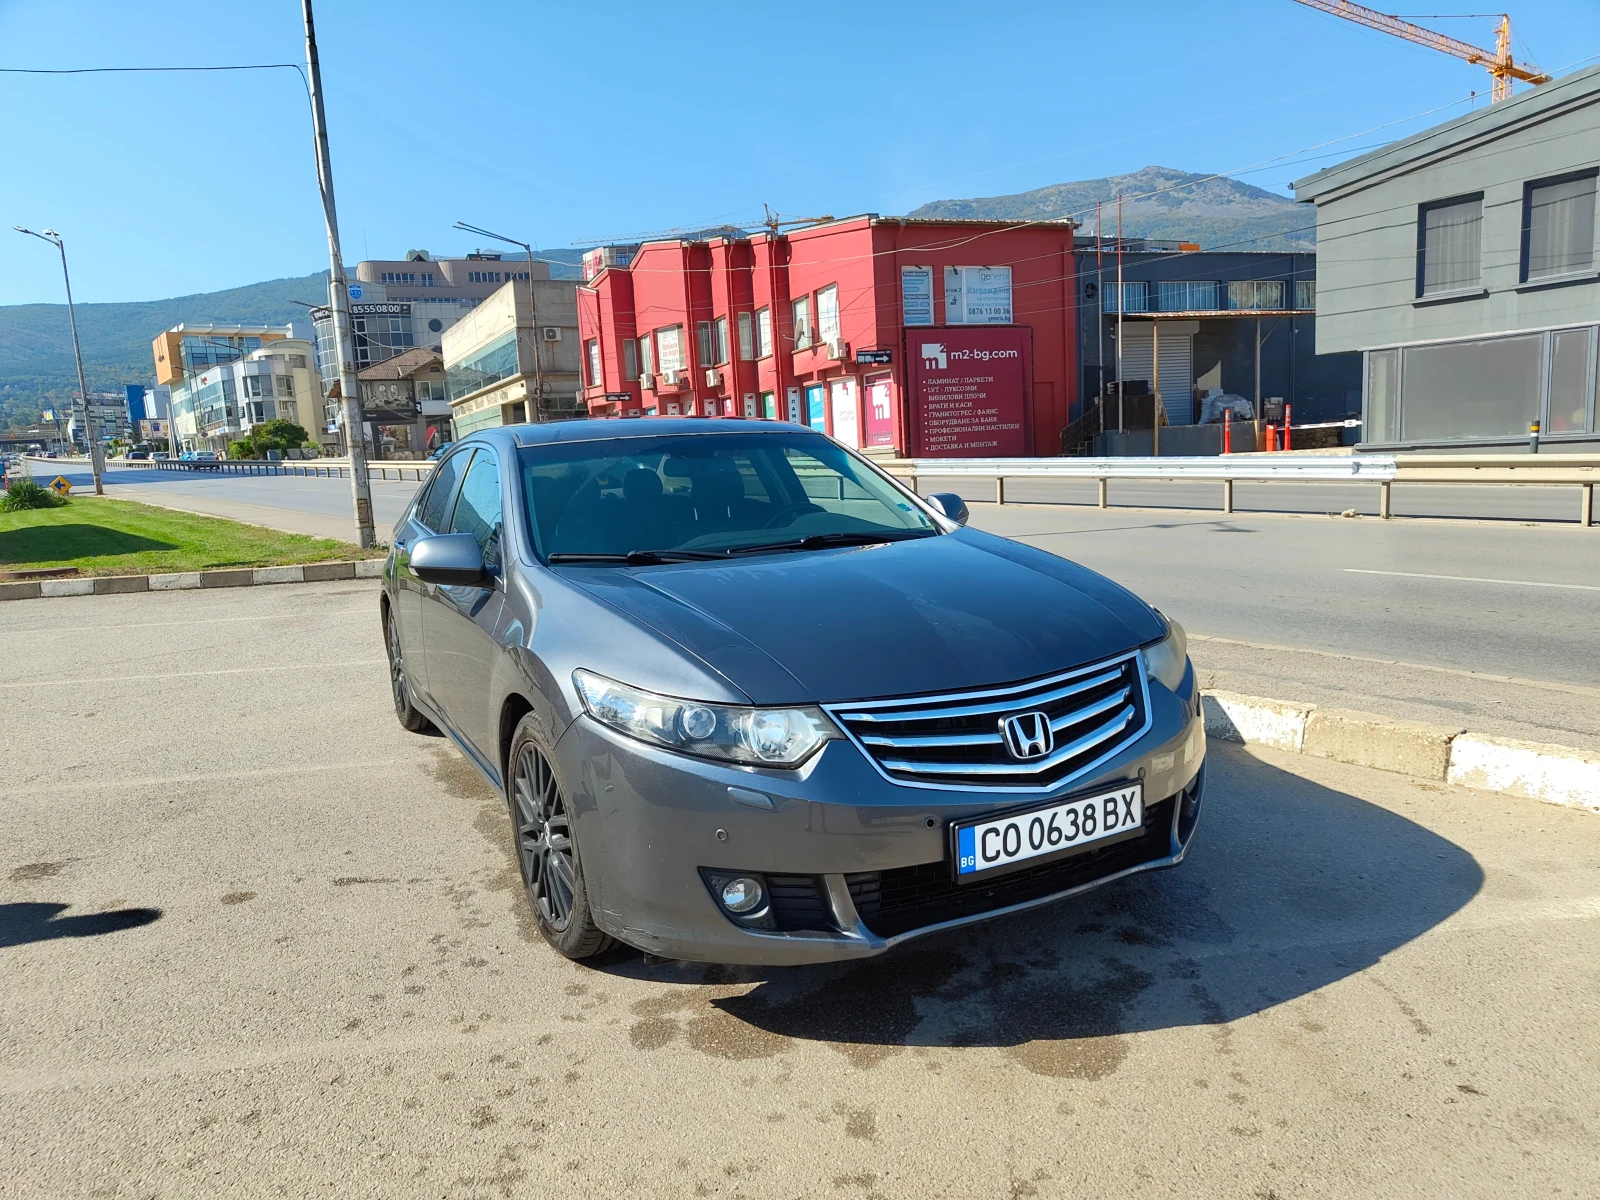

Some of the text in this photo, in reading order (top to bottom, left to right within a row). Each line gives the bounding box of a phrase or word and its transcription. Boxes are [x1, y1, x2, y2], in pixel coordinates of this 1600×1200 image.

[950, 348, 1018, 361] m2-bg.com
[964, 376, 994, 384] ПАРКЕТИ
[929, 410, 972, 418] ГРАНИТОГРЕС
[929, 418, 970, 427] ОБОРУДВАНЕ
[929, 423, 1020, 434] ПРОФЕСИОНАЛНИ НАСТИЛКИ
[930, 443, 963, 451] ДОСТАВКА
[970, 440, 998, 448] МОНТАЖ
[960, 790, 1136, 869] BG CO 0638 BX
